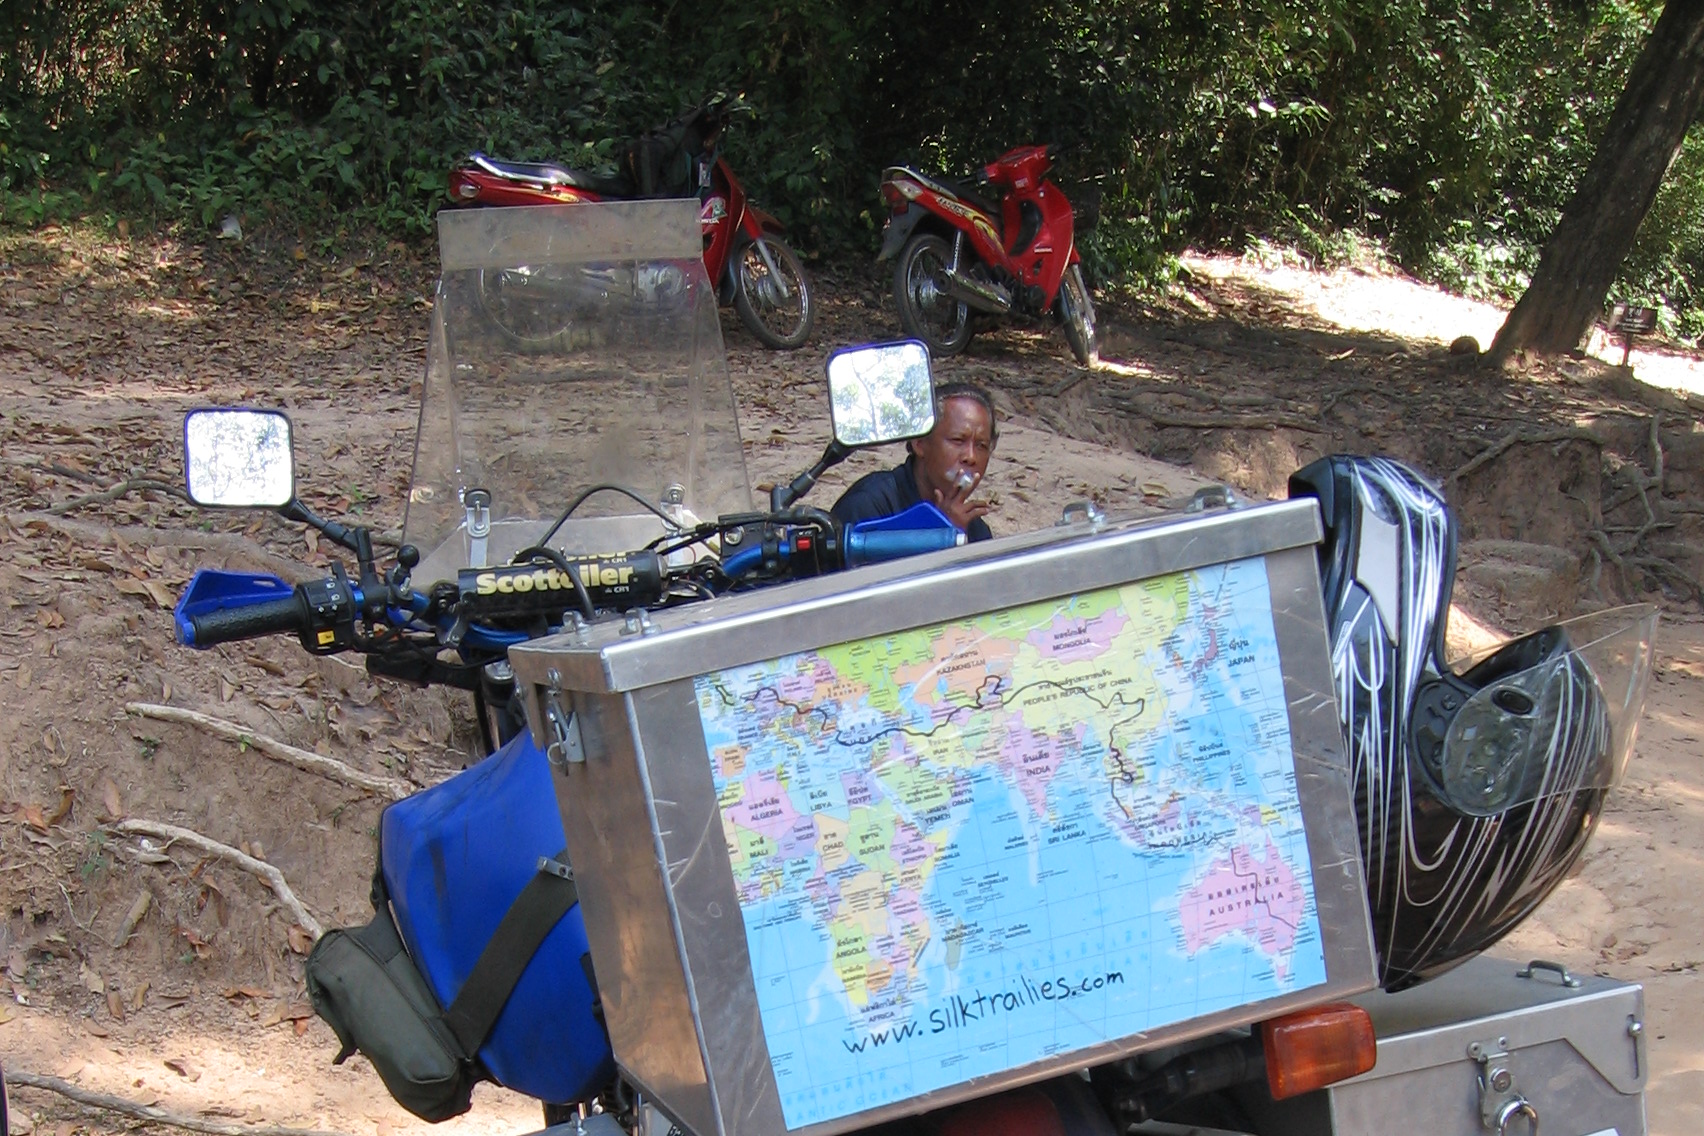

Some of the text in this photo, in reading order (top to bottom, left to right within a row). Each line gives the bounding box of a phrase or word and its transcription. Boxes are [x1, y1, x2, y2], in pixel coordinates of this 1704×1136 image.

[1228, 655, 1255, 667] JAPAN
[1026, 765, 1051, 777] INDIA
[810, 801, 832, 811] LIBYA
[951, 797, 975, 807] OMAN
[750, 809, 783, 822] ALGERIA
[1062, 830, 1087, 841] LANKA
[1209, 891, 1284, 916] AUSTRALIA
[835, 946, 867, 959] ANGOLA
[868, 1011, 895, 1023] AFRICA
